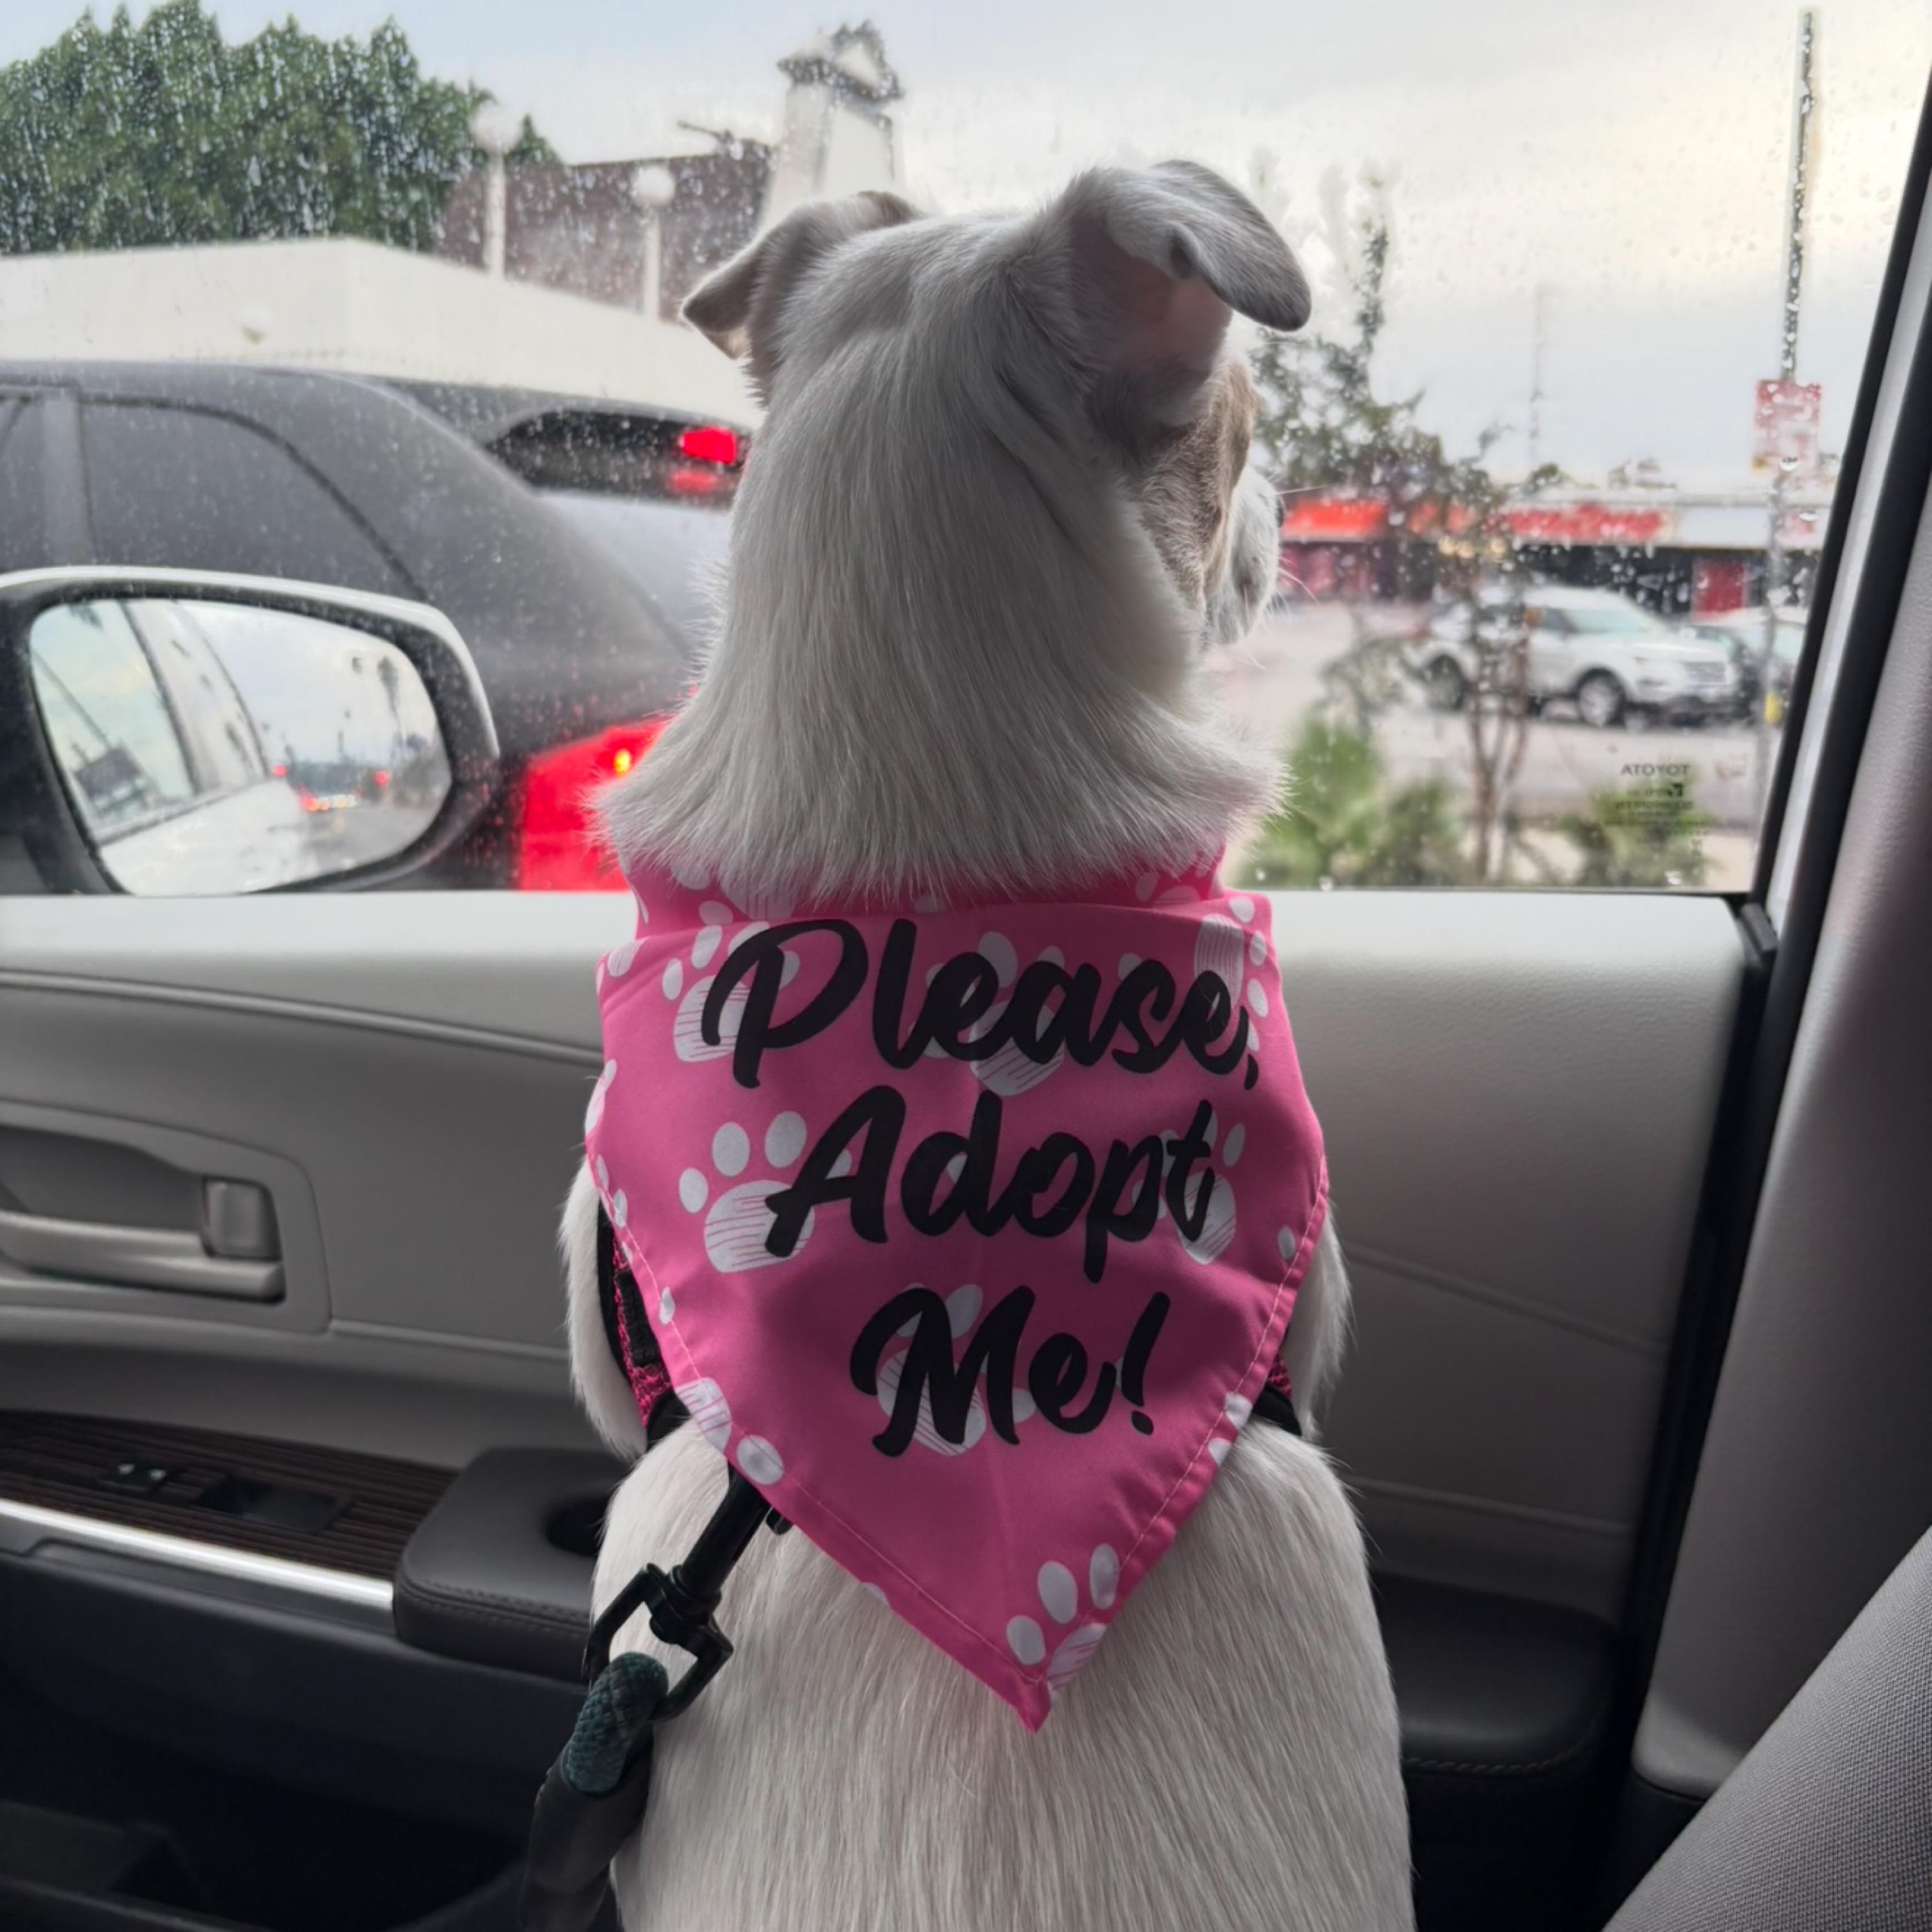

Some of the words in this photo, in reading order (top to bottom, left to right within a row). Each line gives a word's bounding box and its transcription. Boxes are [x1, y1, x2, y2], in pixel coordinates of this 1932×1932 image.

[701, 919, 1258, 1090] Please,
[765, 1085, 1216, 1284] Adopt
[850, 1285, 1170, 1457] Me!
